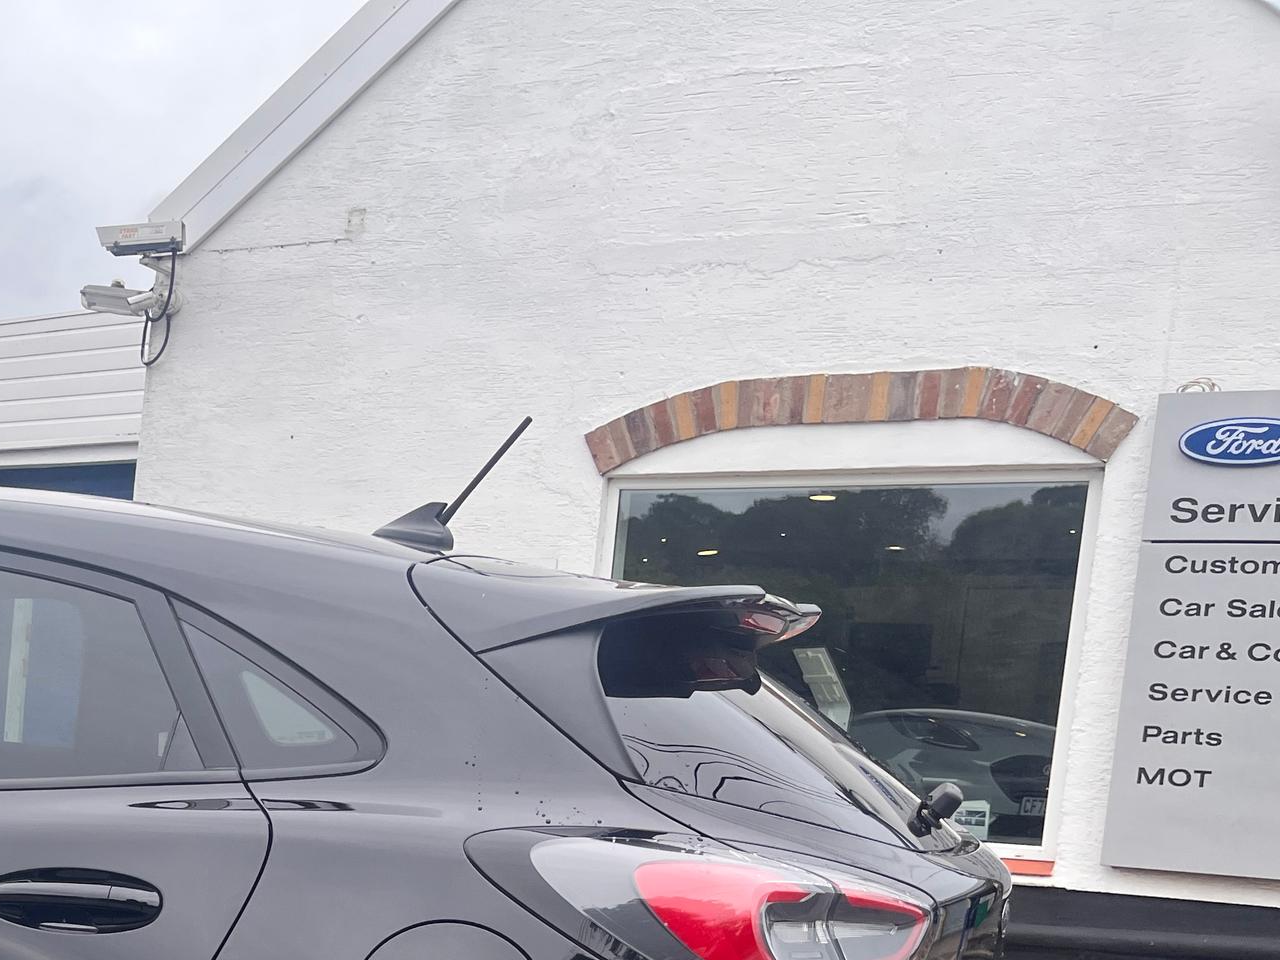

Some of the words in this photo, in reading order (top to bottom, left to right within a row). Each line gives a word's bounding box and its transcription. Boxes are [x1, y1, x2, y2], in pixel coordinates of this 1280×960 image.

[1170, 497, 1280, 523] Servi
[1160, 598, 1215, 616] Car
[1227, 599, 1280, 618] Sal
[1154, 640, 1210, 659] Car
[1216, 642, 1237, 661] &
[1148, 682, 1273, 705] Service
[1142, 725, 1223, 746] Parts
[1136, 766, 1212, 788] MOT
